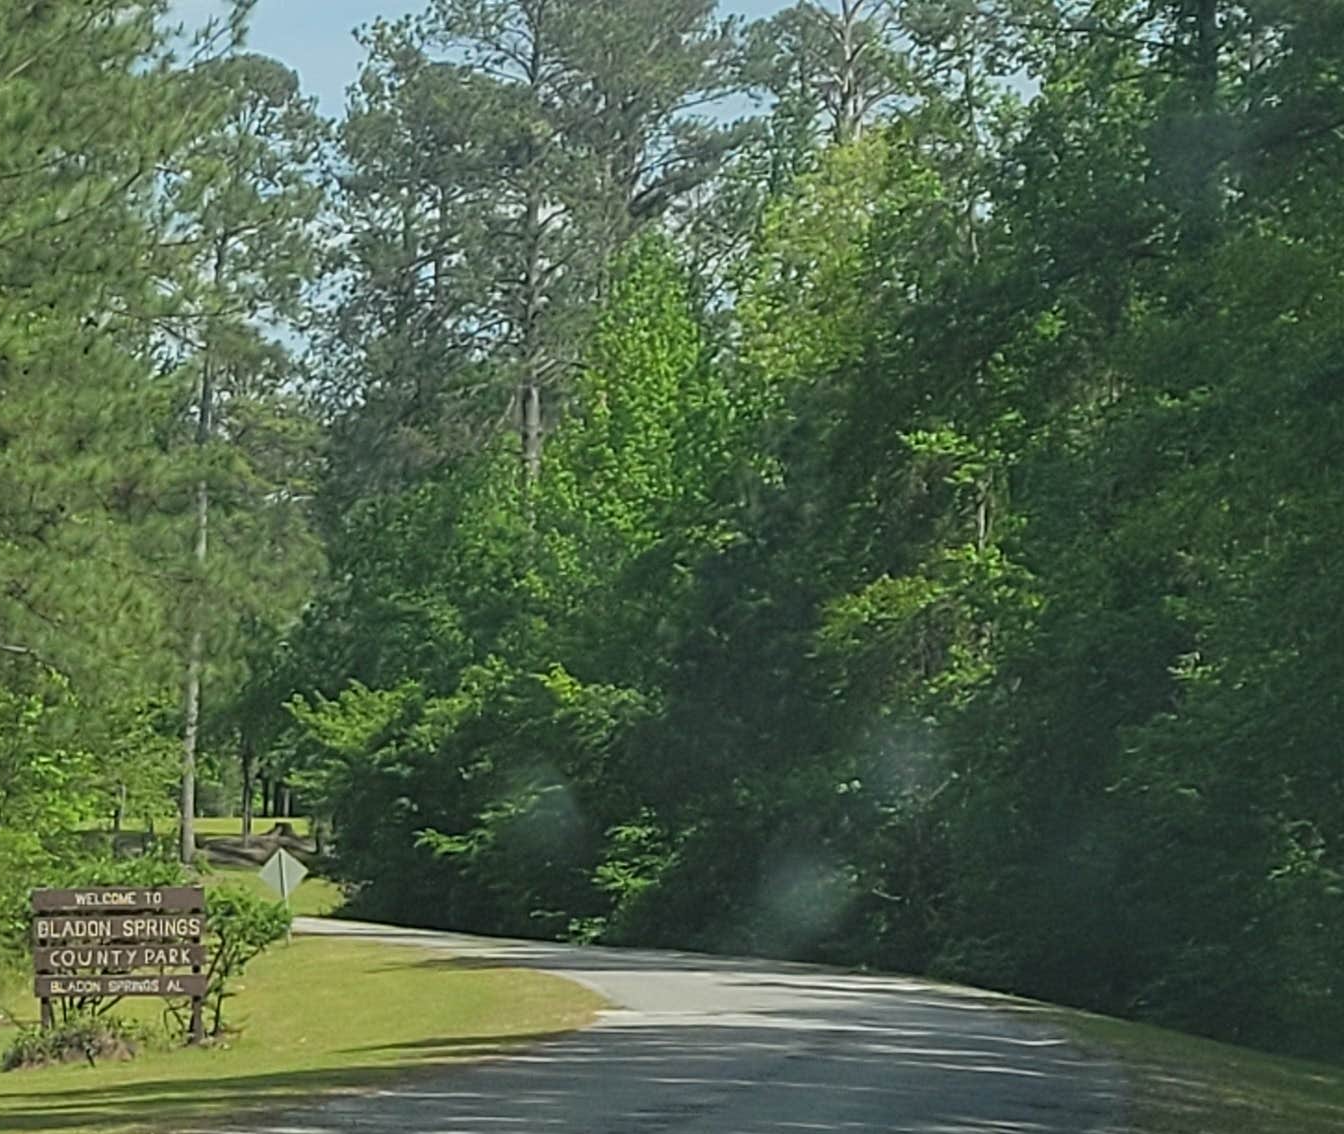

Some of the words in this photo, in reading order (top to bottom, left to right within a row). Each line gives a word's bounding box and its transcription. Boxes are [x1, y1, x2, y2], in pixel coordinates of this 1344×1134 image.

[74, 891, 137, 906] WELCOME
[145, 892, 162, 904] TO
[37, 919, 112, 938] BLADON
[122, 918, 201, 937] SPRINGS
[49, 949, 138, 967] COUNTY
[144, 948, 192, 965] PARK
[50, 979, 102, 994] BLADON
[107, 979, 160, 993] SPRINGS
[166, 980, 185, 993] AL
